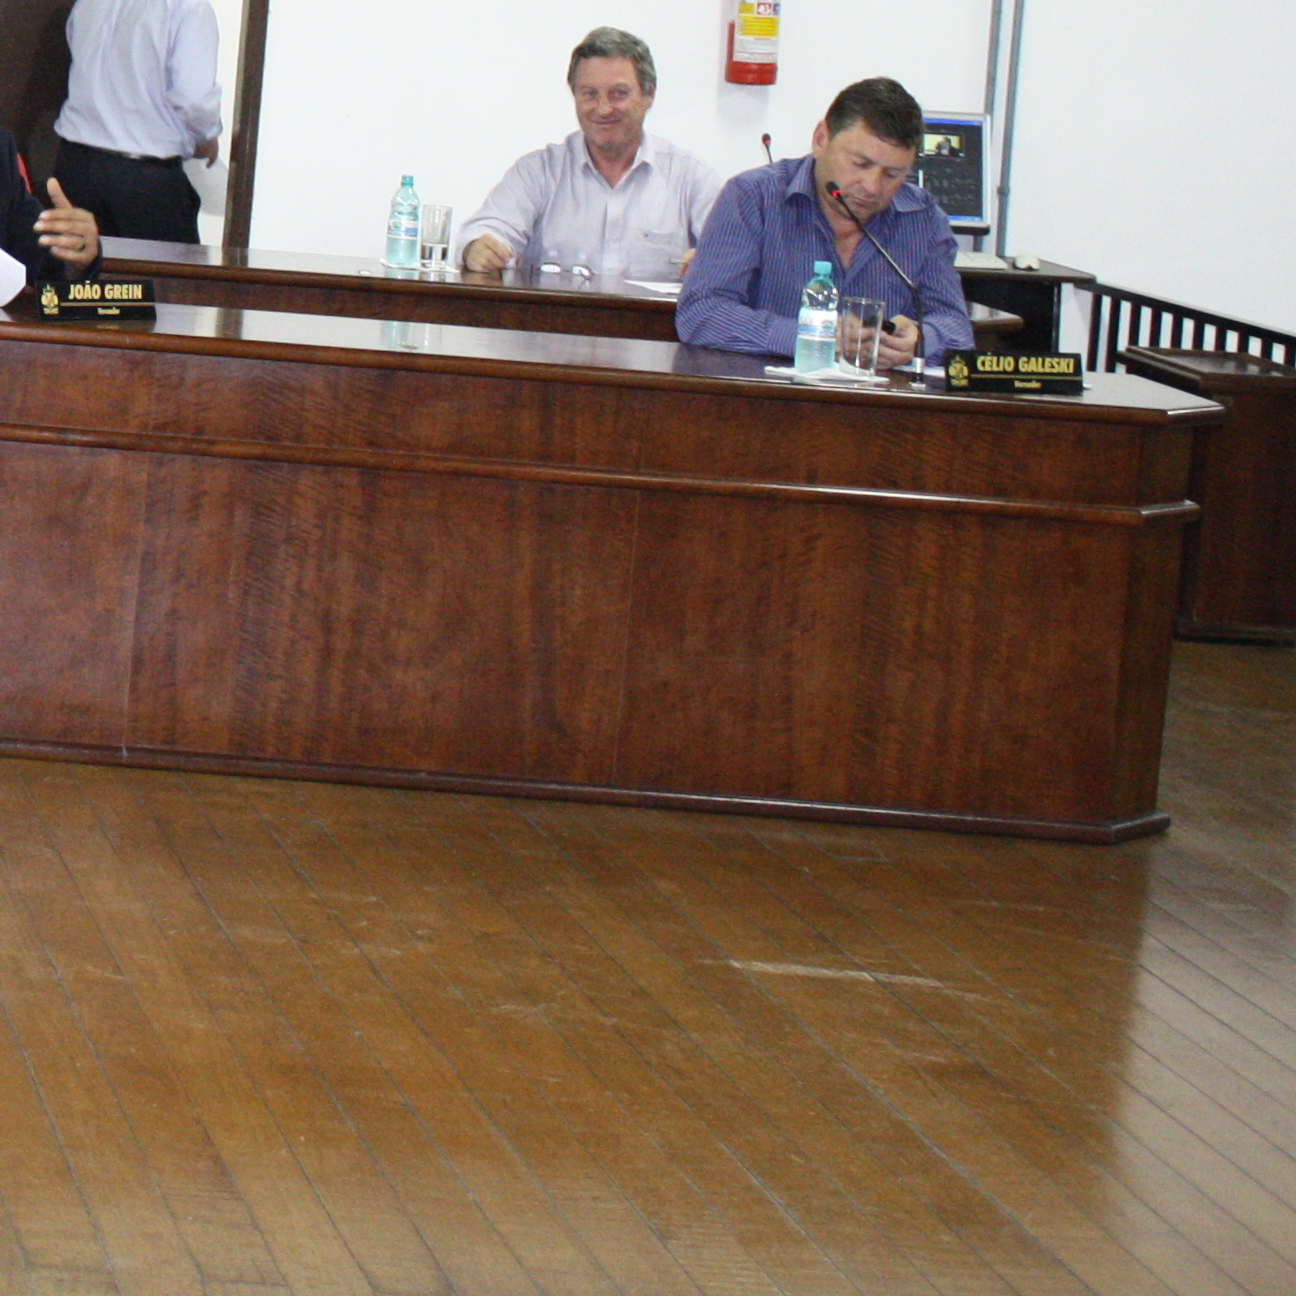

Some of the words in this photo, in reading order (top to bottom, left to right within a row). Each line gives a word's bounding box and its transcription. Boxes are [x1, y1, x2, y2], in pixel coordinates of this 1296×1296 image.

[68, 280, 101, 299] JOÃO
[104, 283, 142, 299] GREIN
[976, 352, 1015, 372] CÉLIO
[1018, 356, 1074, 373] GALESKI
